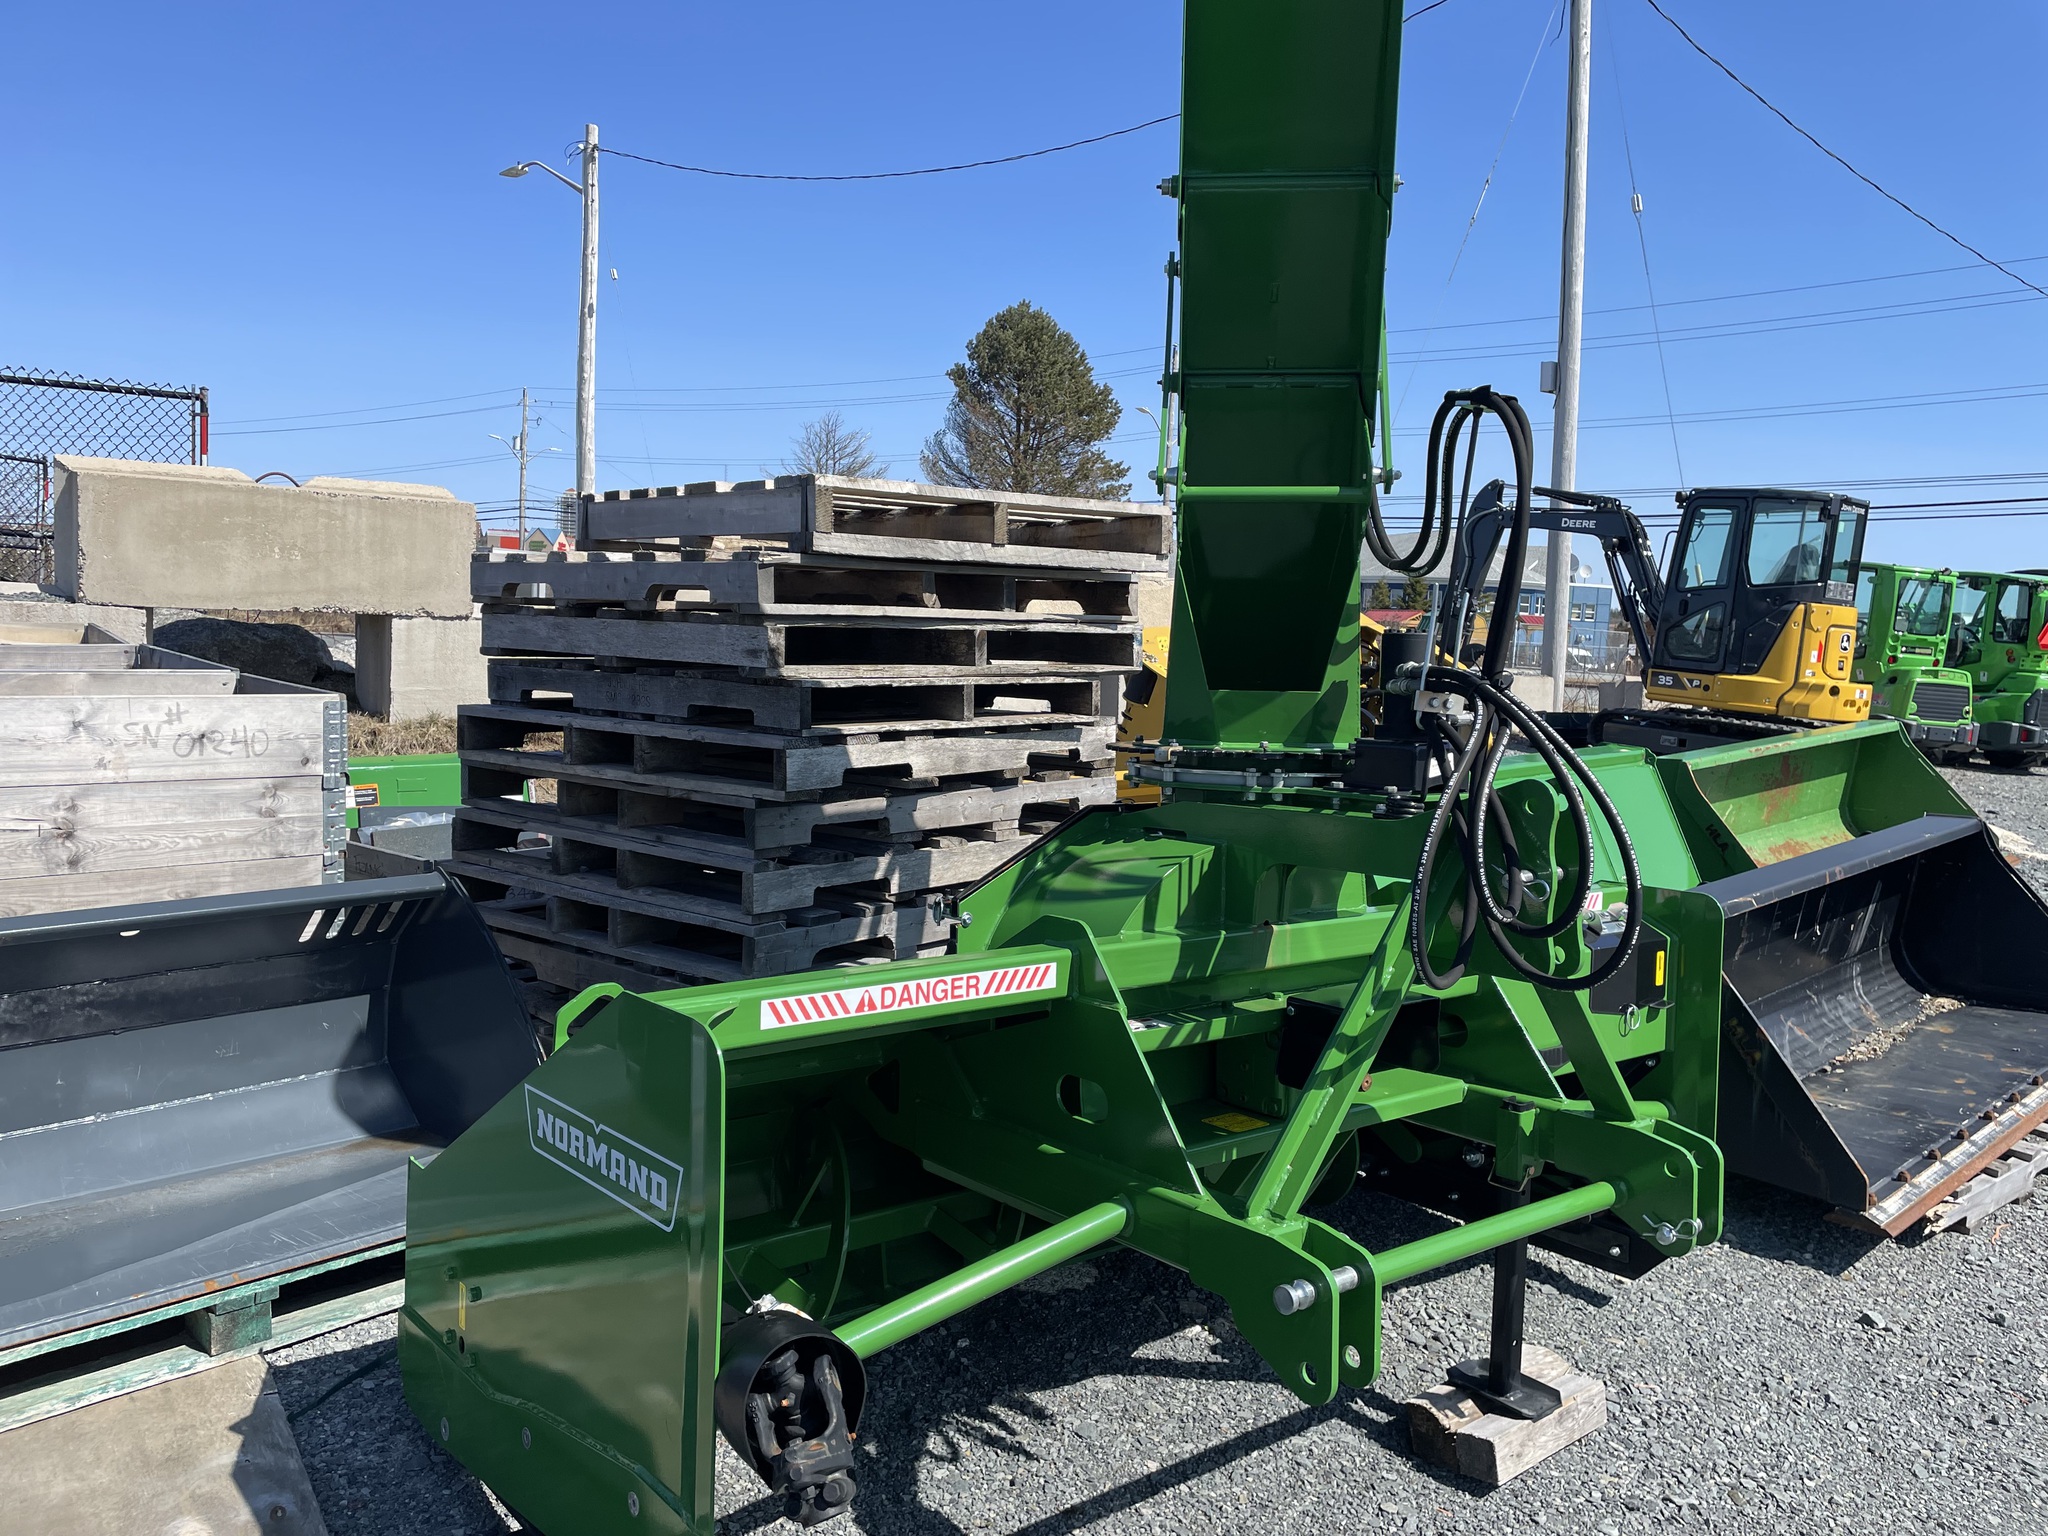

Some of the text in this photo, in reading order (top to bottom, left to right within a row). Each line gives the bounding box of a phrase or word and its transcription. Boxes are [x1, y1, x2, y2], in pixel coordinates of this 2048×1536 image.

[1561, 518, 1597, 528] DEERE
[1658, 675, 1673, 686] 35
[1434, 808, 1442, 818] PSI
[1423, 836, 1433, 851] BAR
[1420, 852, 1428, 864] 330
[880, 975, 981, 1009] DANGER
[537, 1107, 667, 1212] NORMAND
